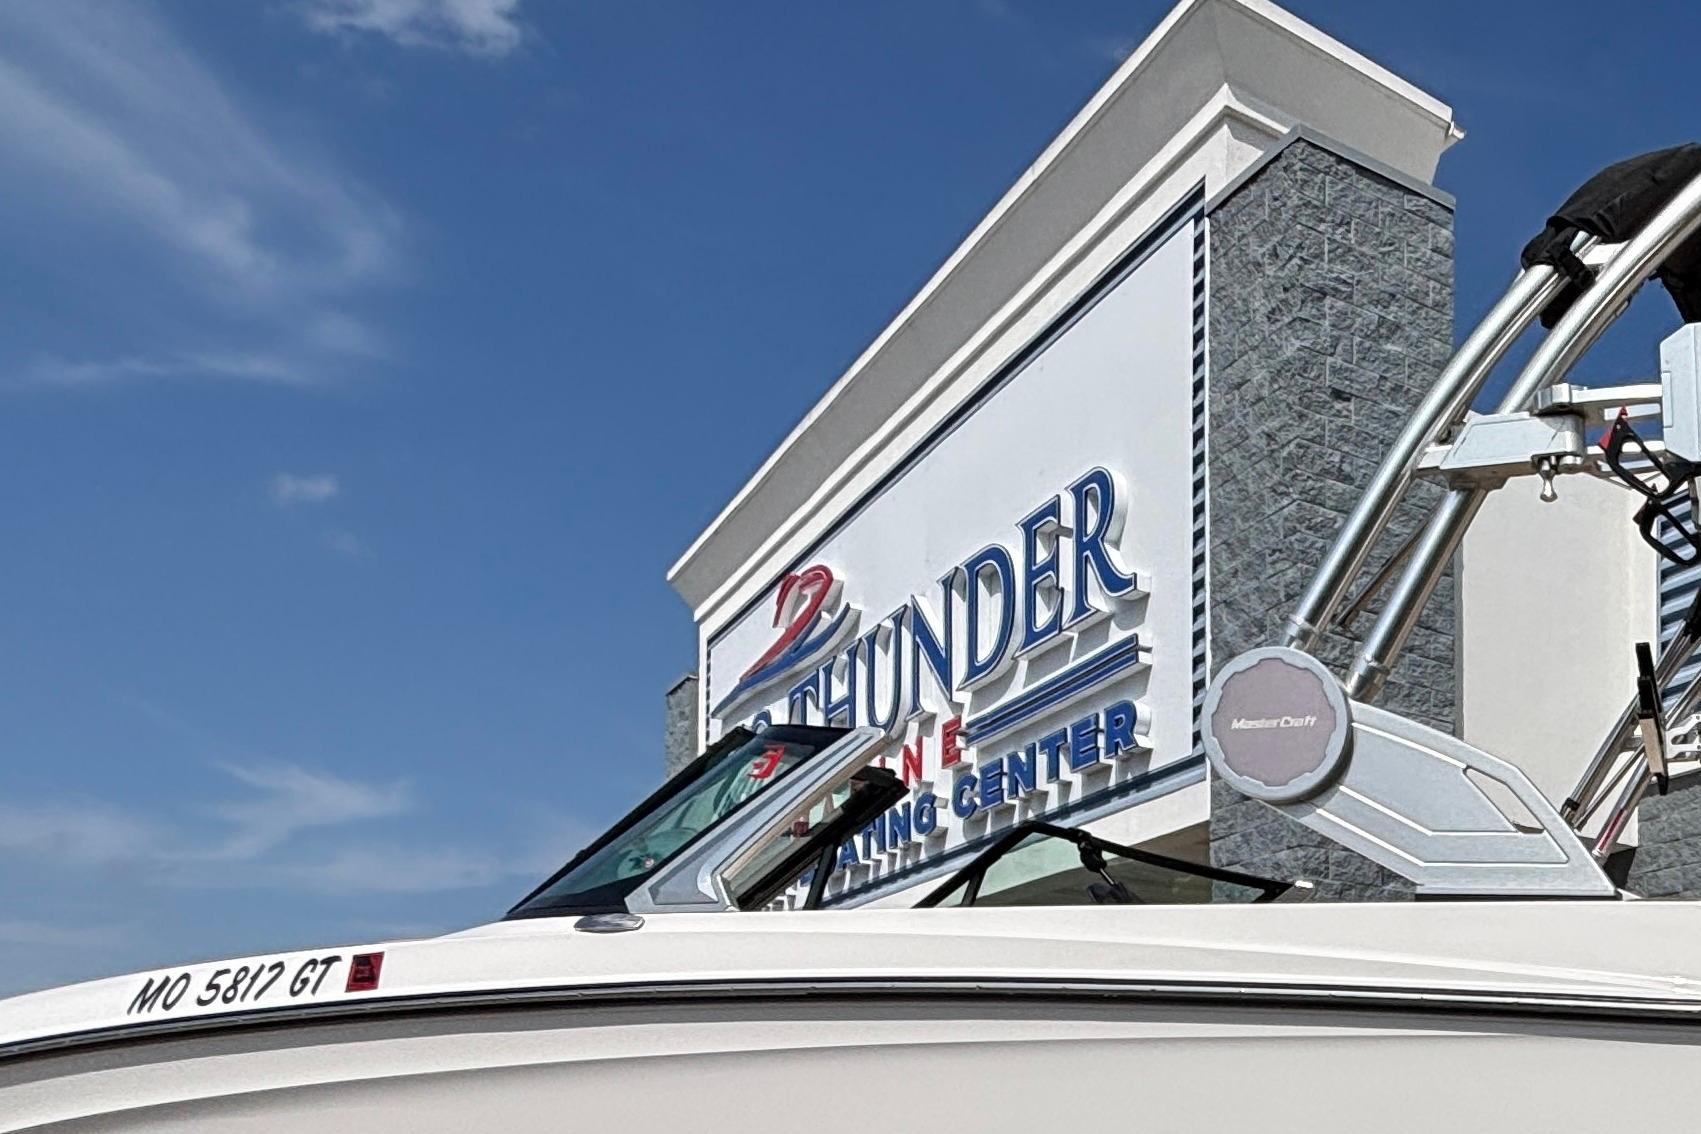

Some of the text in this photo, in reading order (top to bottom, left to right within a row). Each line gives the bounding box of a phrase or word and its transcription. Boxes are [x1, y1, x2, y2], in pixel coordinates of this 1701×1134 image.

[787, 465, 1137, 736] THUNDER
[1231, 715, 1317, 730] MasterCraft
[800, 792, 937, 886] ATING
[952, 700, 1137, 820] CENTER
[127, 972, 191, 1015] MO
[196, 961, 286, 1007] 5817
[289, 955, 342, 998] GT
